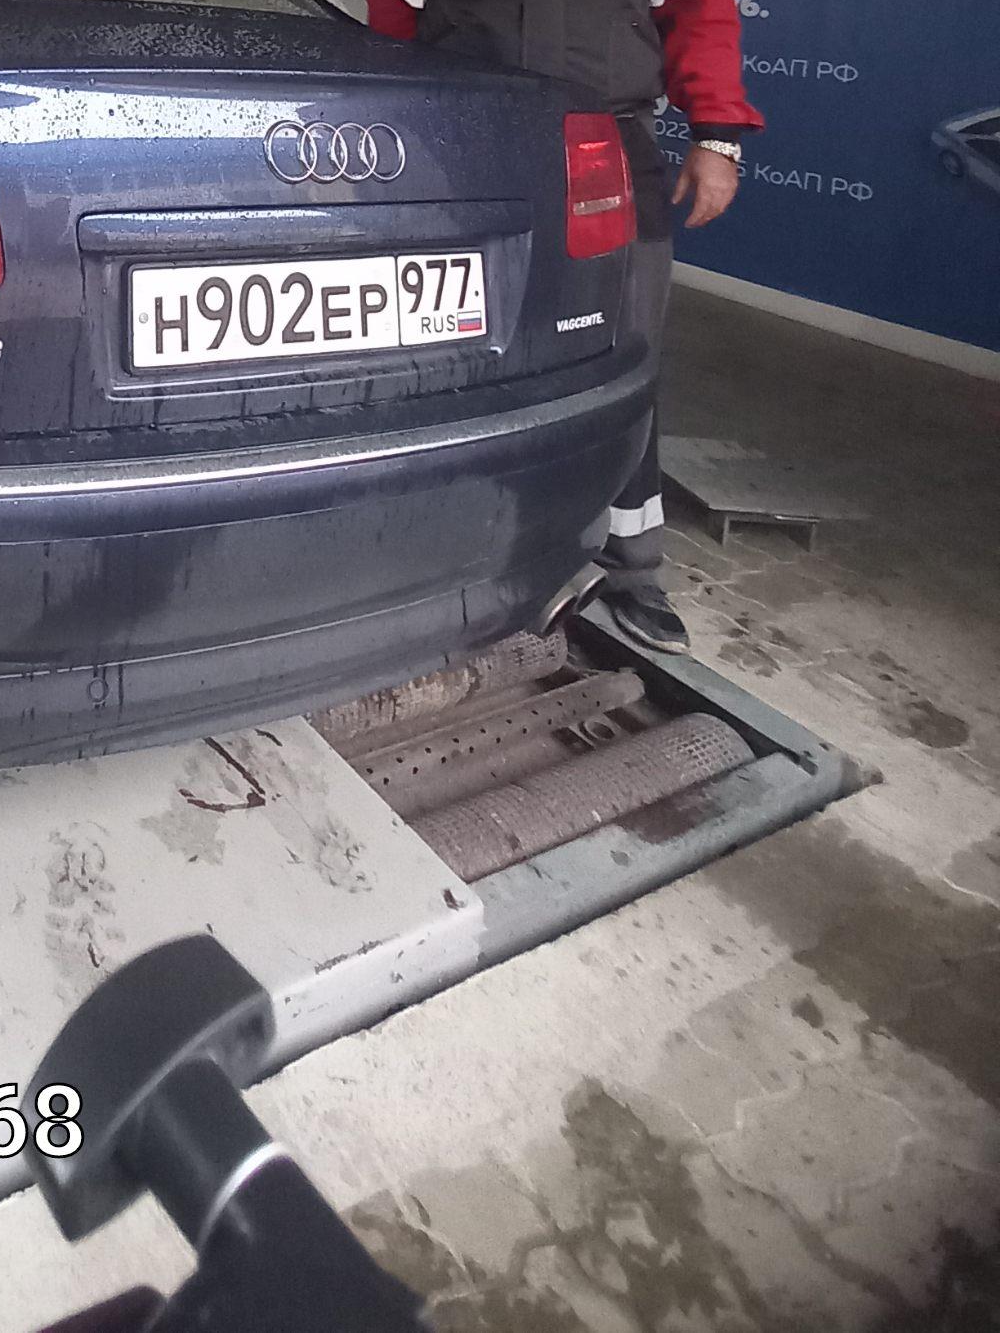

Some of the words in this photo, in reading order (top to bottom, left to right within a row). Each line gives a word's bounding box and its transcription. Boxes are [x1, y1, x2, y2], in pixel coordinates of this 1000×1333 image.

[743, 54, 808, 79] КоАП
[816, 61, 859, 83] РФ
[755, 163, 824, 193] КоАП
[831, 176, 874, 202] РФ
[400, 257, 473, 315] 977
[419, 315, 457, 336] RUS
